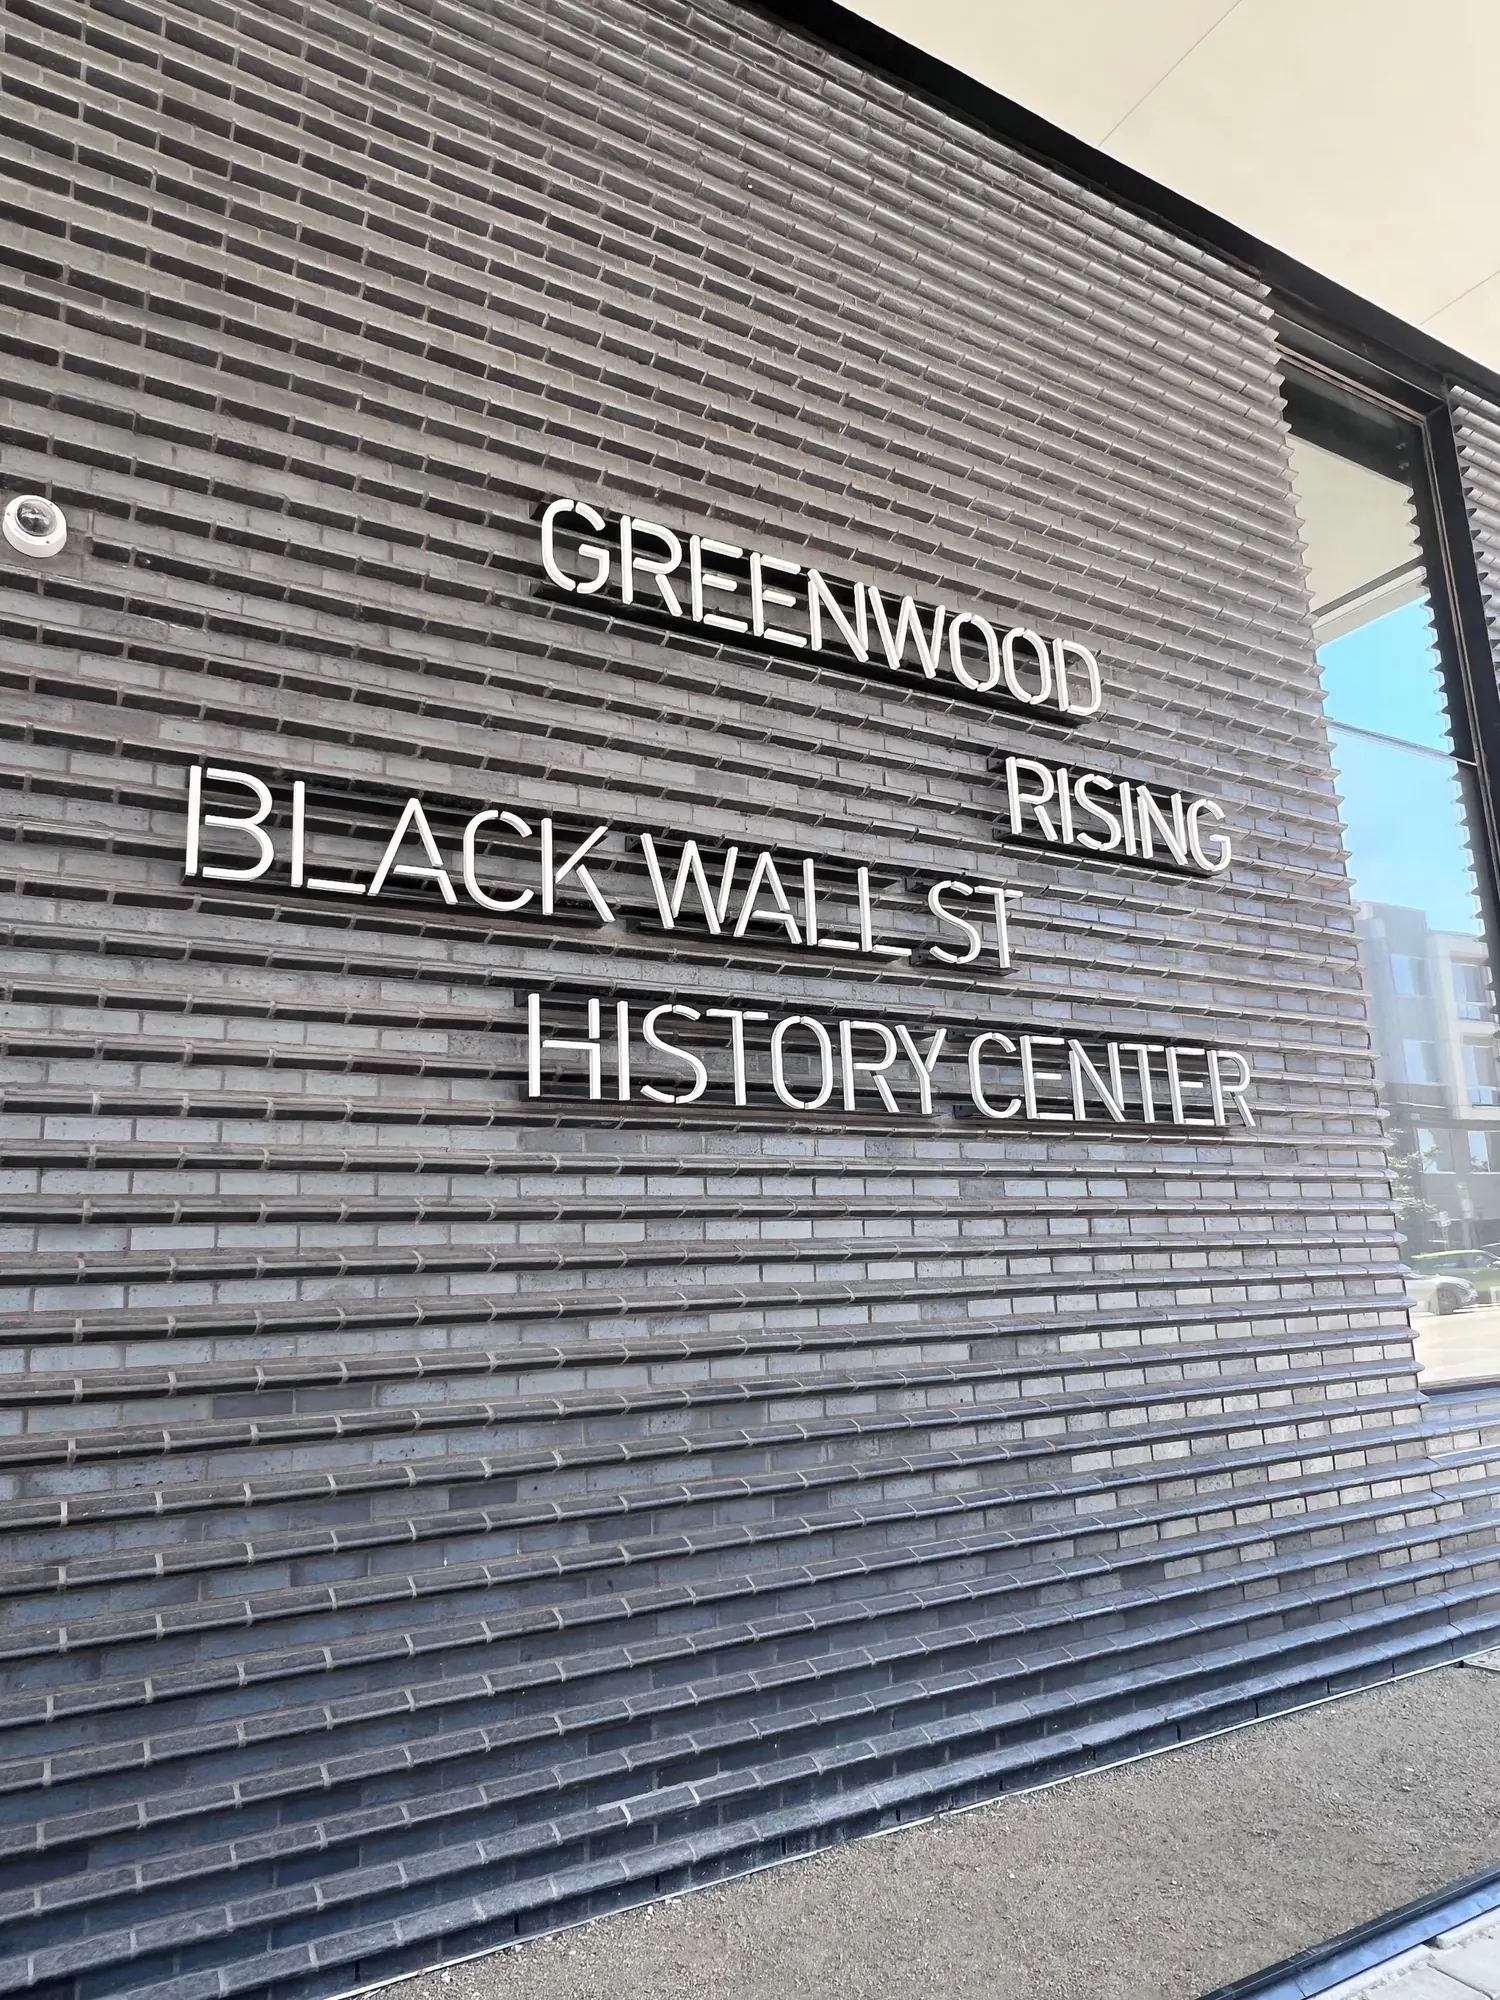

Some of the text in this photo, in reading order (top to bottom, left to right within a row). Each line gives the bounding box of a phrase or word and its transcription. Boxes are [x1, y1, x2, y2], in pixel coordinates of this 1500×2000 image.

[541, 499, 1101, 715] GREENWOOD
[185, 765, 1023, 968] BLACK WALL ST
[1006, 756, 1232, 872] RISING
[528, 993, 1256, 1127] HISTORY CENTER
